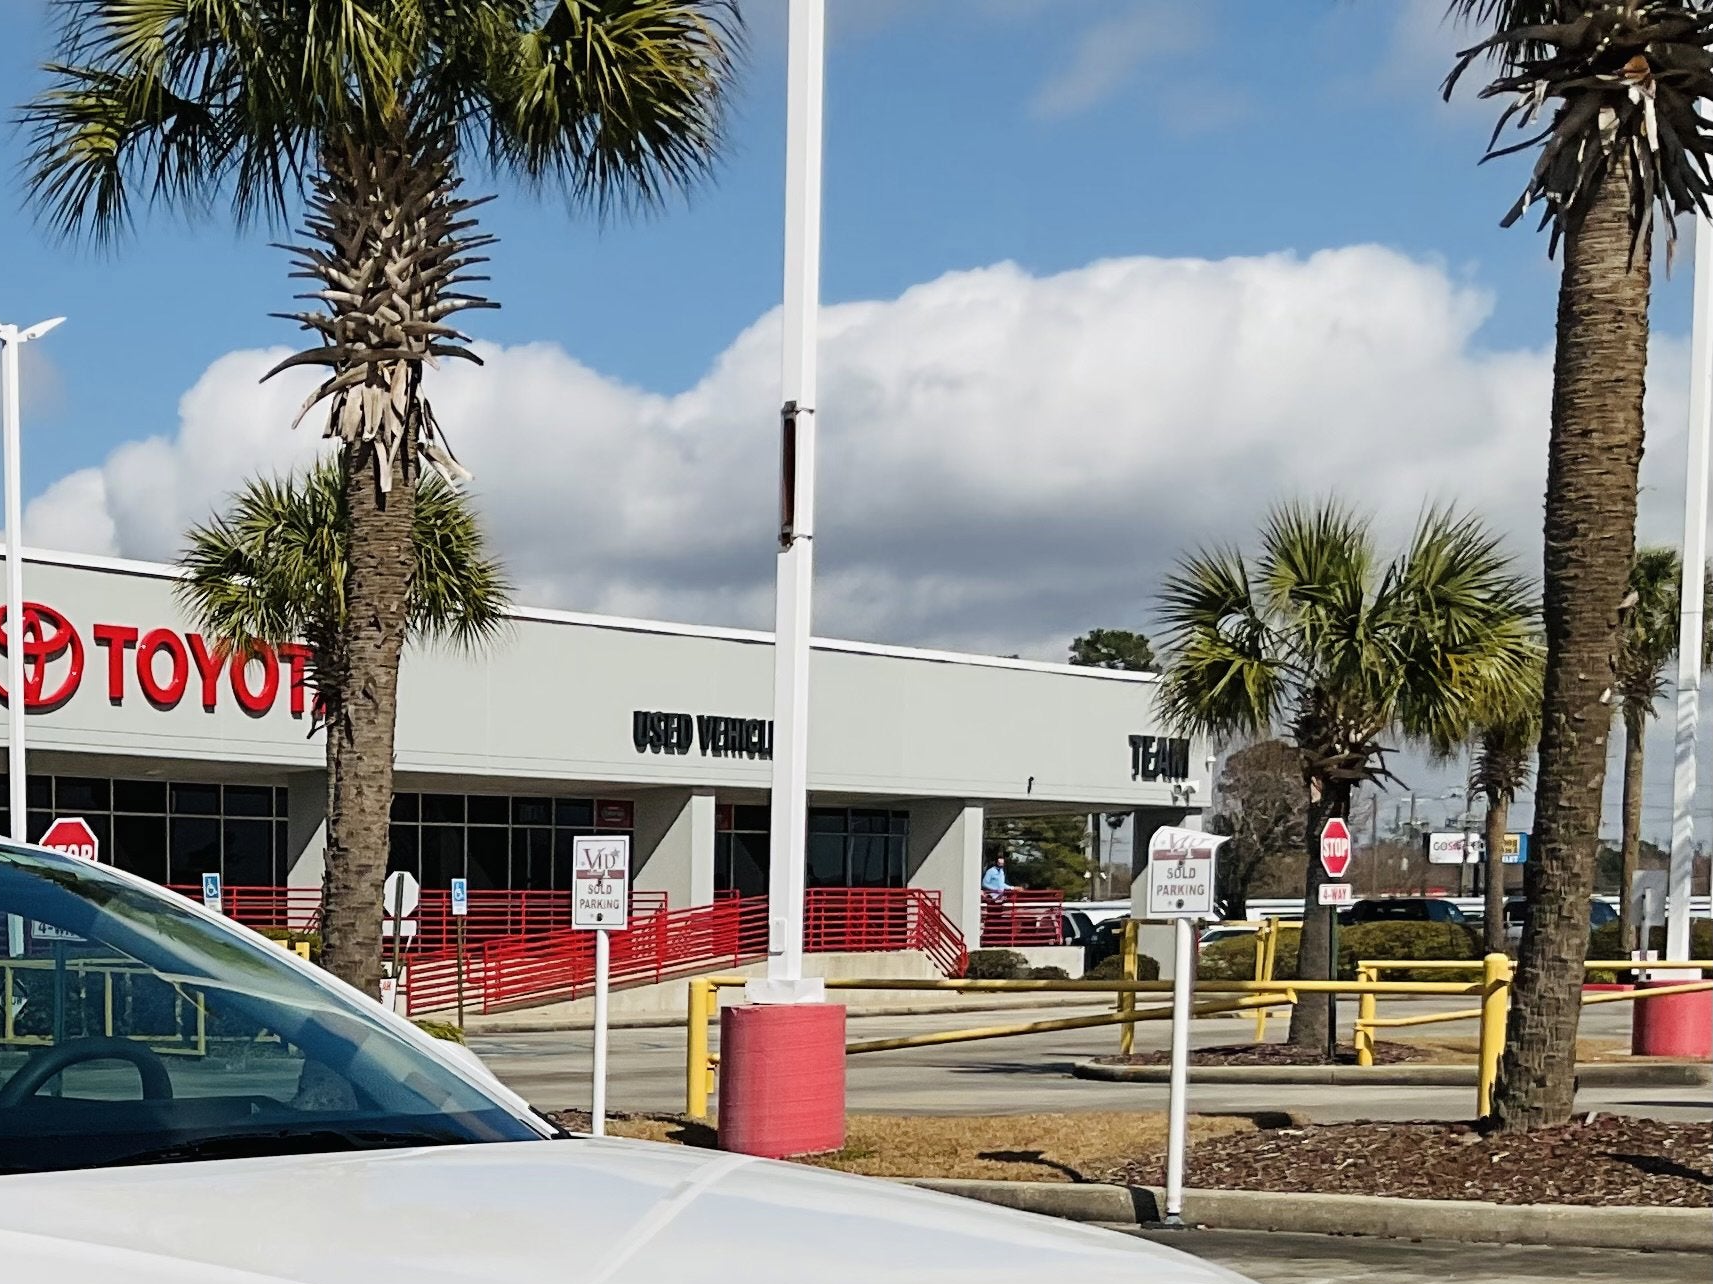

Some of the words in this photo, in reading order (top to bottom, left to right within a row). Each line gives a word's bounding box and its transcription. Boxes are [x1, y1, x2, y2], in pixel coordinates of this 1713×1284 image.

[92, 623, 327, 719] TOYOT
[633, 710, 693, 756] USED
[696, 714, 774, 761] VEHICL
[1128, 734, 1190, 782] TEAM
[1323, 837, 1348, 857] STOP
[1167, 867, 1196, 879] SOLD
[588, 884, 612, 895] SOLD
[1156, 884, 1205, 896] PARKING
[1323, 888, 1347, 901] 4-WAY
[579, 898, 619, 909] PARKING
